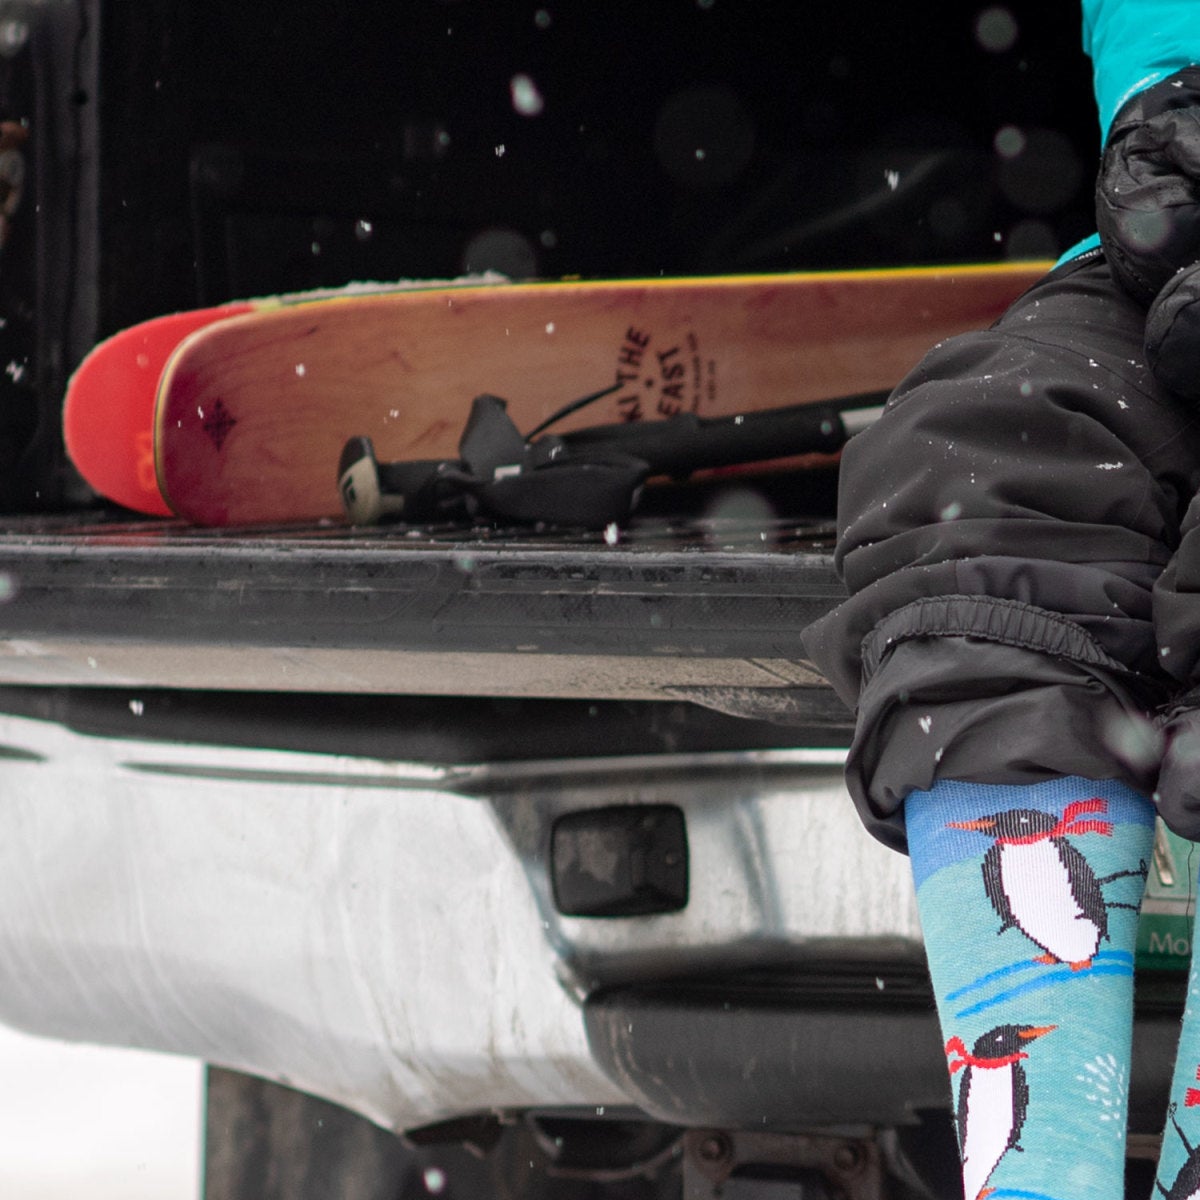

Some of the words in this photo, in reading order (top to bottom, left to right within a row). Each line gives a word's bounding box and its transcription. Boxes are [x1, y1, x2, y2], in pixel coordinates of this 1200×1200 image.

[615, 326, 650, 386] THE
[656, 347, 686, 418] EAST
[615, 394, 644, 423] KI
